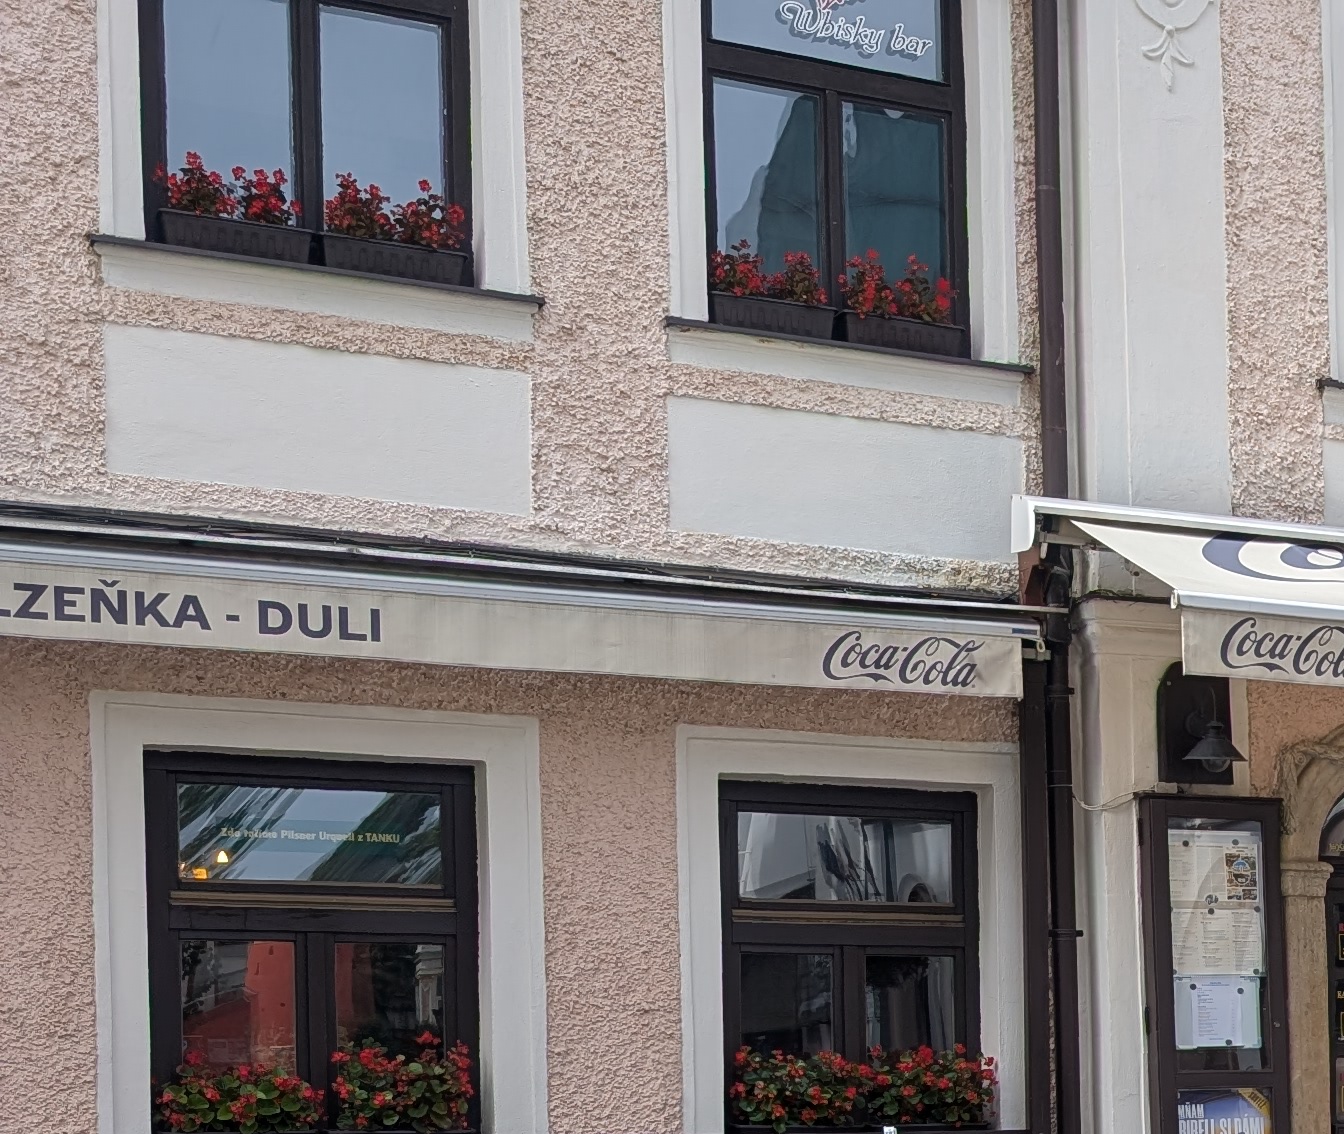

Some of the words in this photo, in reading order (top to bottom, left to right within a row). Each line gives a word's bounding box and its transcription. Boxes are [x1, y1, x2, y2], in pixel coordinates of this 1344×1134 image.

[780, 1, 884, 53] Whisky
[891, 23, 933, 56] bar
[0, 578, 212, 631] ZEŇKA
[257, 599, 381, 643] DULI
[822, 630, 983, 690] Coca-Cola
[281, 830, 316, 841] Pilsner
[319, 831, 355, 843] Urquell
[365, 833, 400, 844] TANKU
[1177, 1101, 1205, 1120] MŇAM
